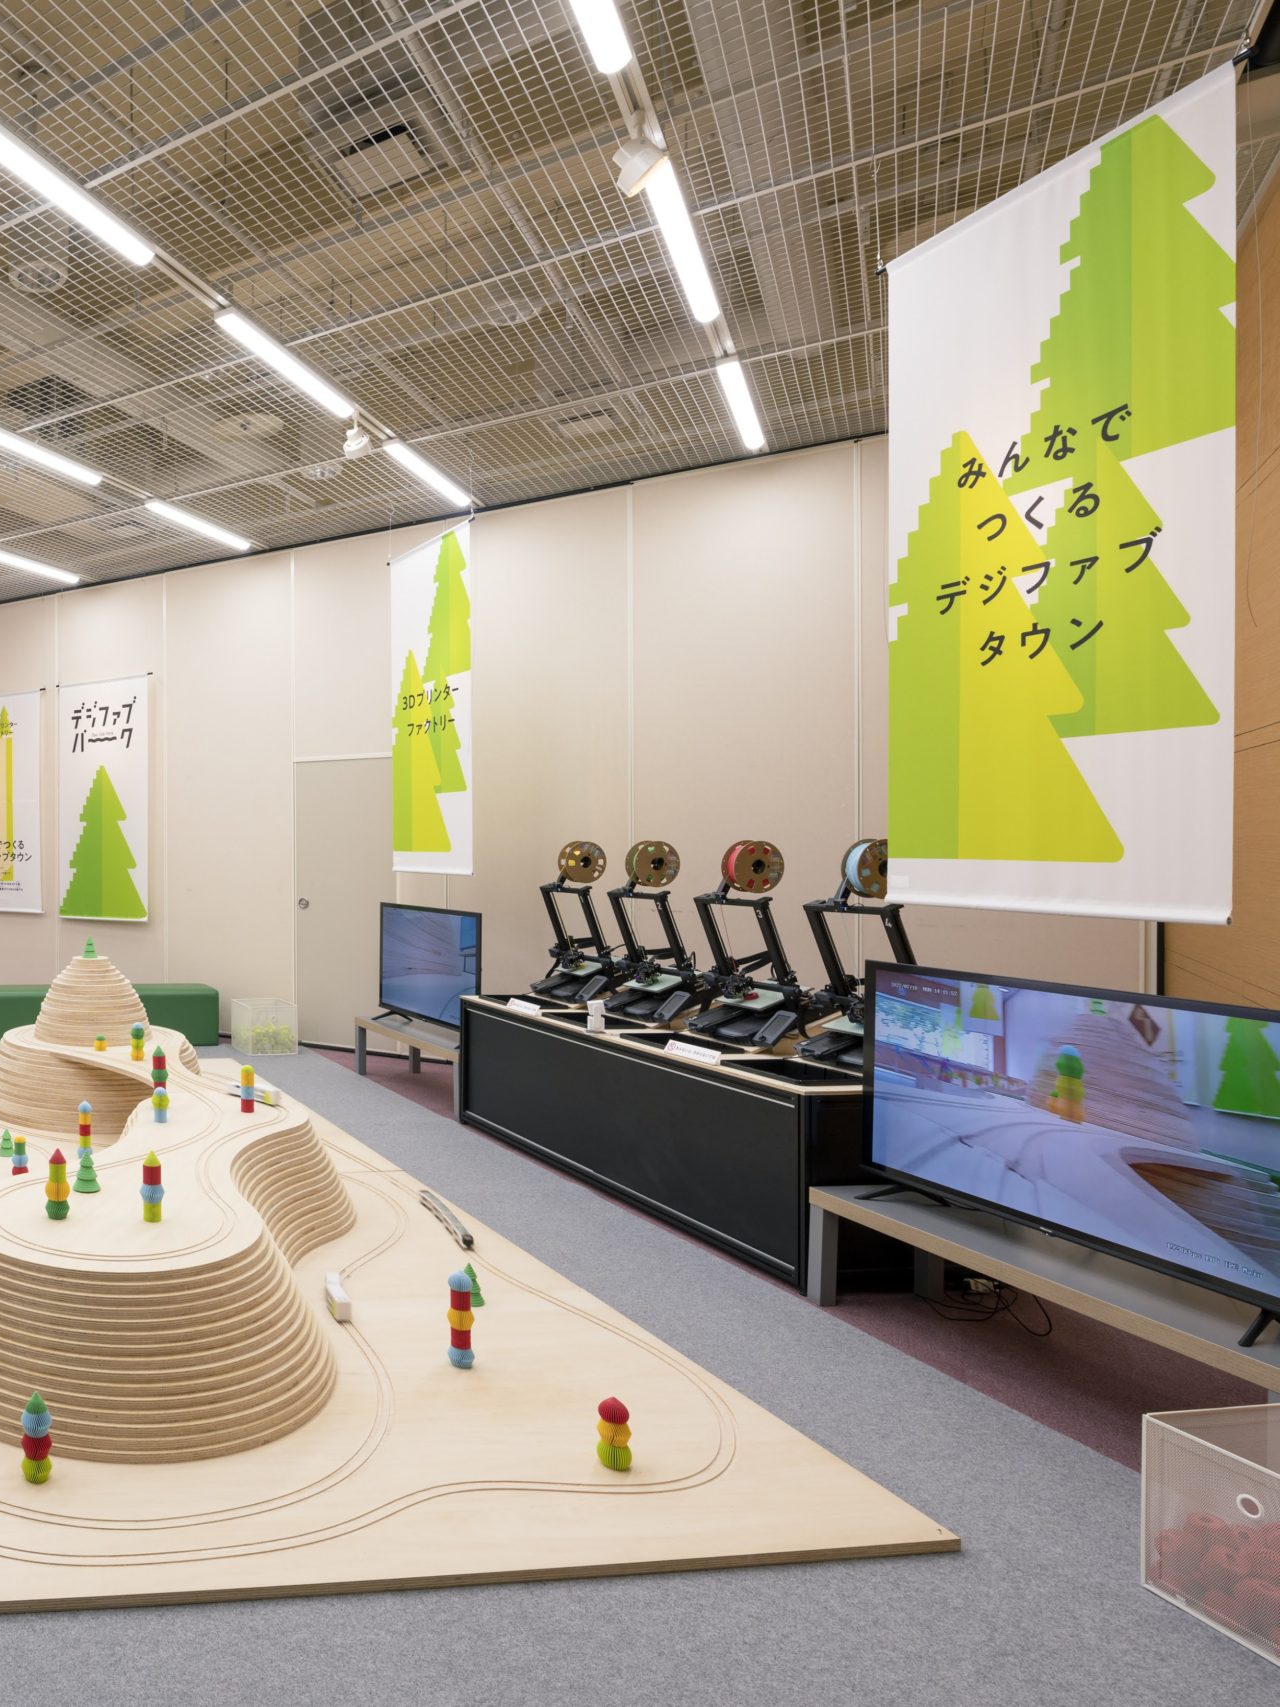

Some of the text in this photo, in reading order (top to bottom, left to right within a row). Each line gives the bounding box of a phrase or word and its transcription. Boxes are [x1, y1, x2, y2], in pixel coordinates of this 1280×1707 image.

[957, 403, 1133, 490] みんなで
[976, 481, 1101, 542] つくる
[935, 525, 1163, 616] デジファブ
[979, 617, 1104, 667] タウン
[71, 695, 137, 730] デジファブ
[402, 683, 460, 711] 3Dプリンター
[72, 727, 134, 753] パーク
[407, 713, 456, 737] ファクトリー
[755, 909, 764, 920] 3
